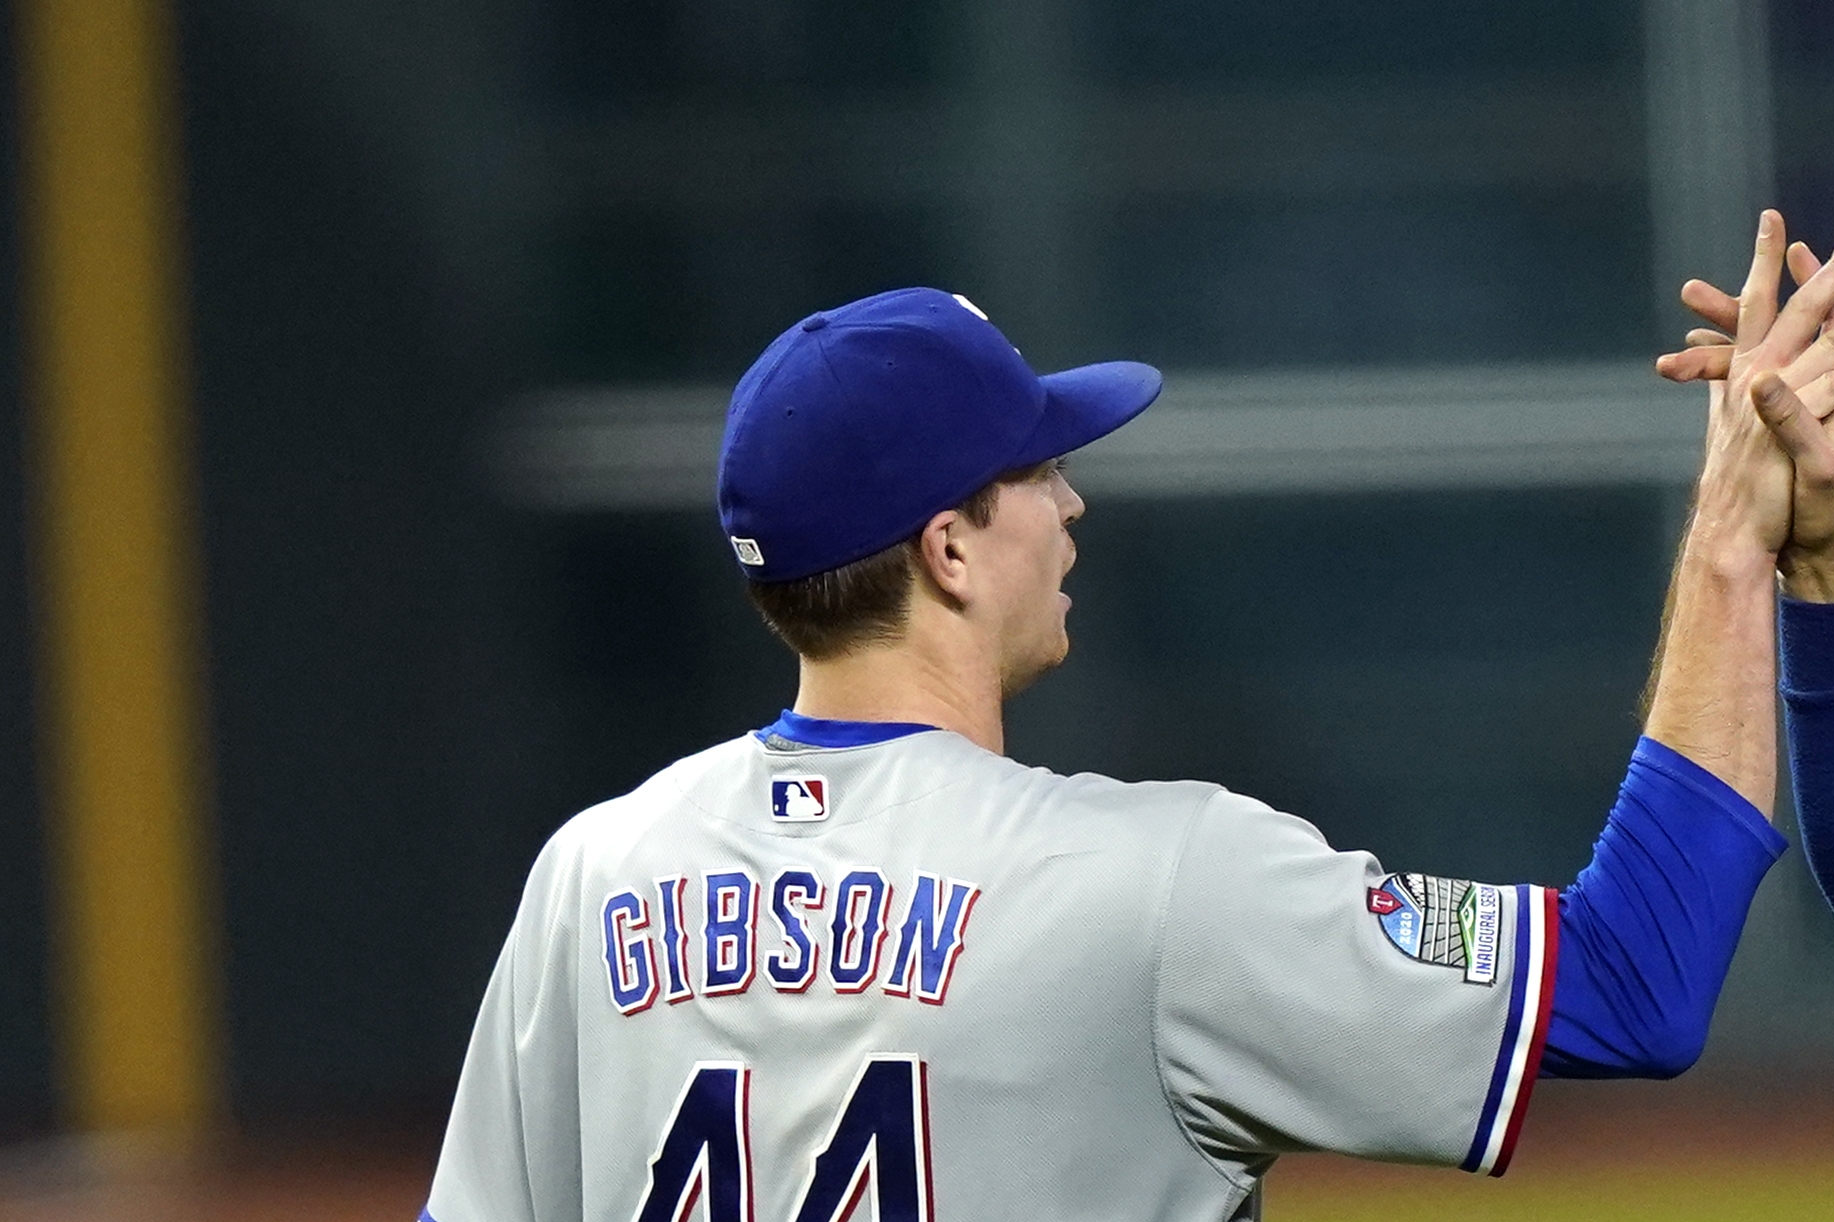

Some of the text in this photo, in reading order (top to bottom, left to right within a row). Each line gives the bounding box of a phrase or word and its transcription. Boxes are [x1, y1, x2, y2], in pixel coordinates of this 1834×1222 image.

[600, 865, 982, 1016] GIBSON
[1399, 911, 1413, 945] 2020
[1475, 910, 1497, 976] INAUGURAL
